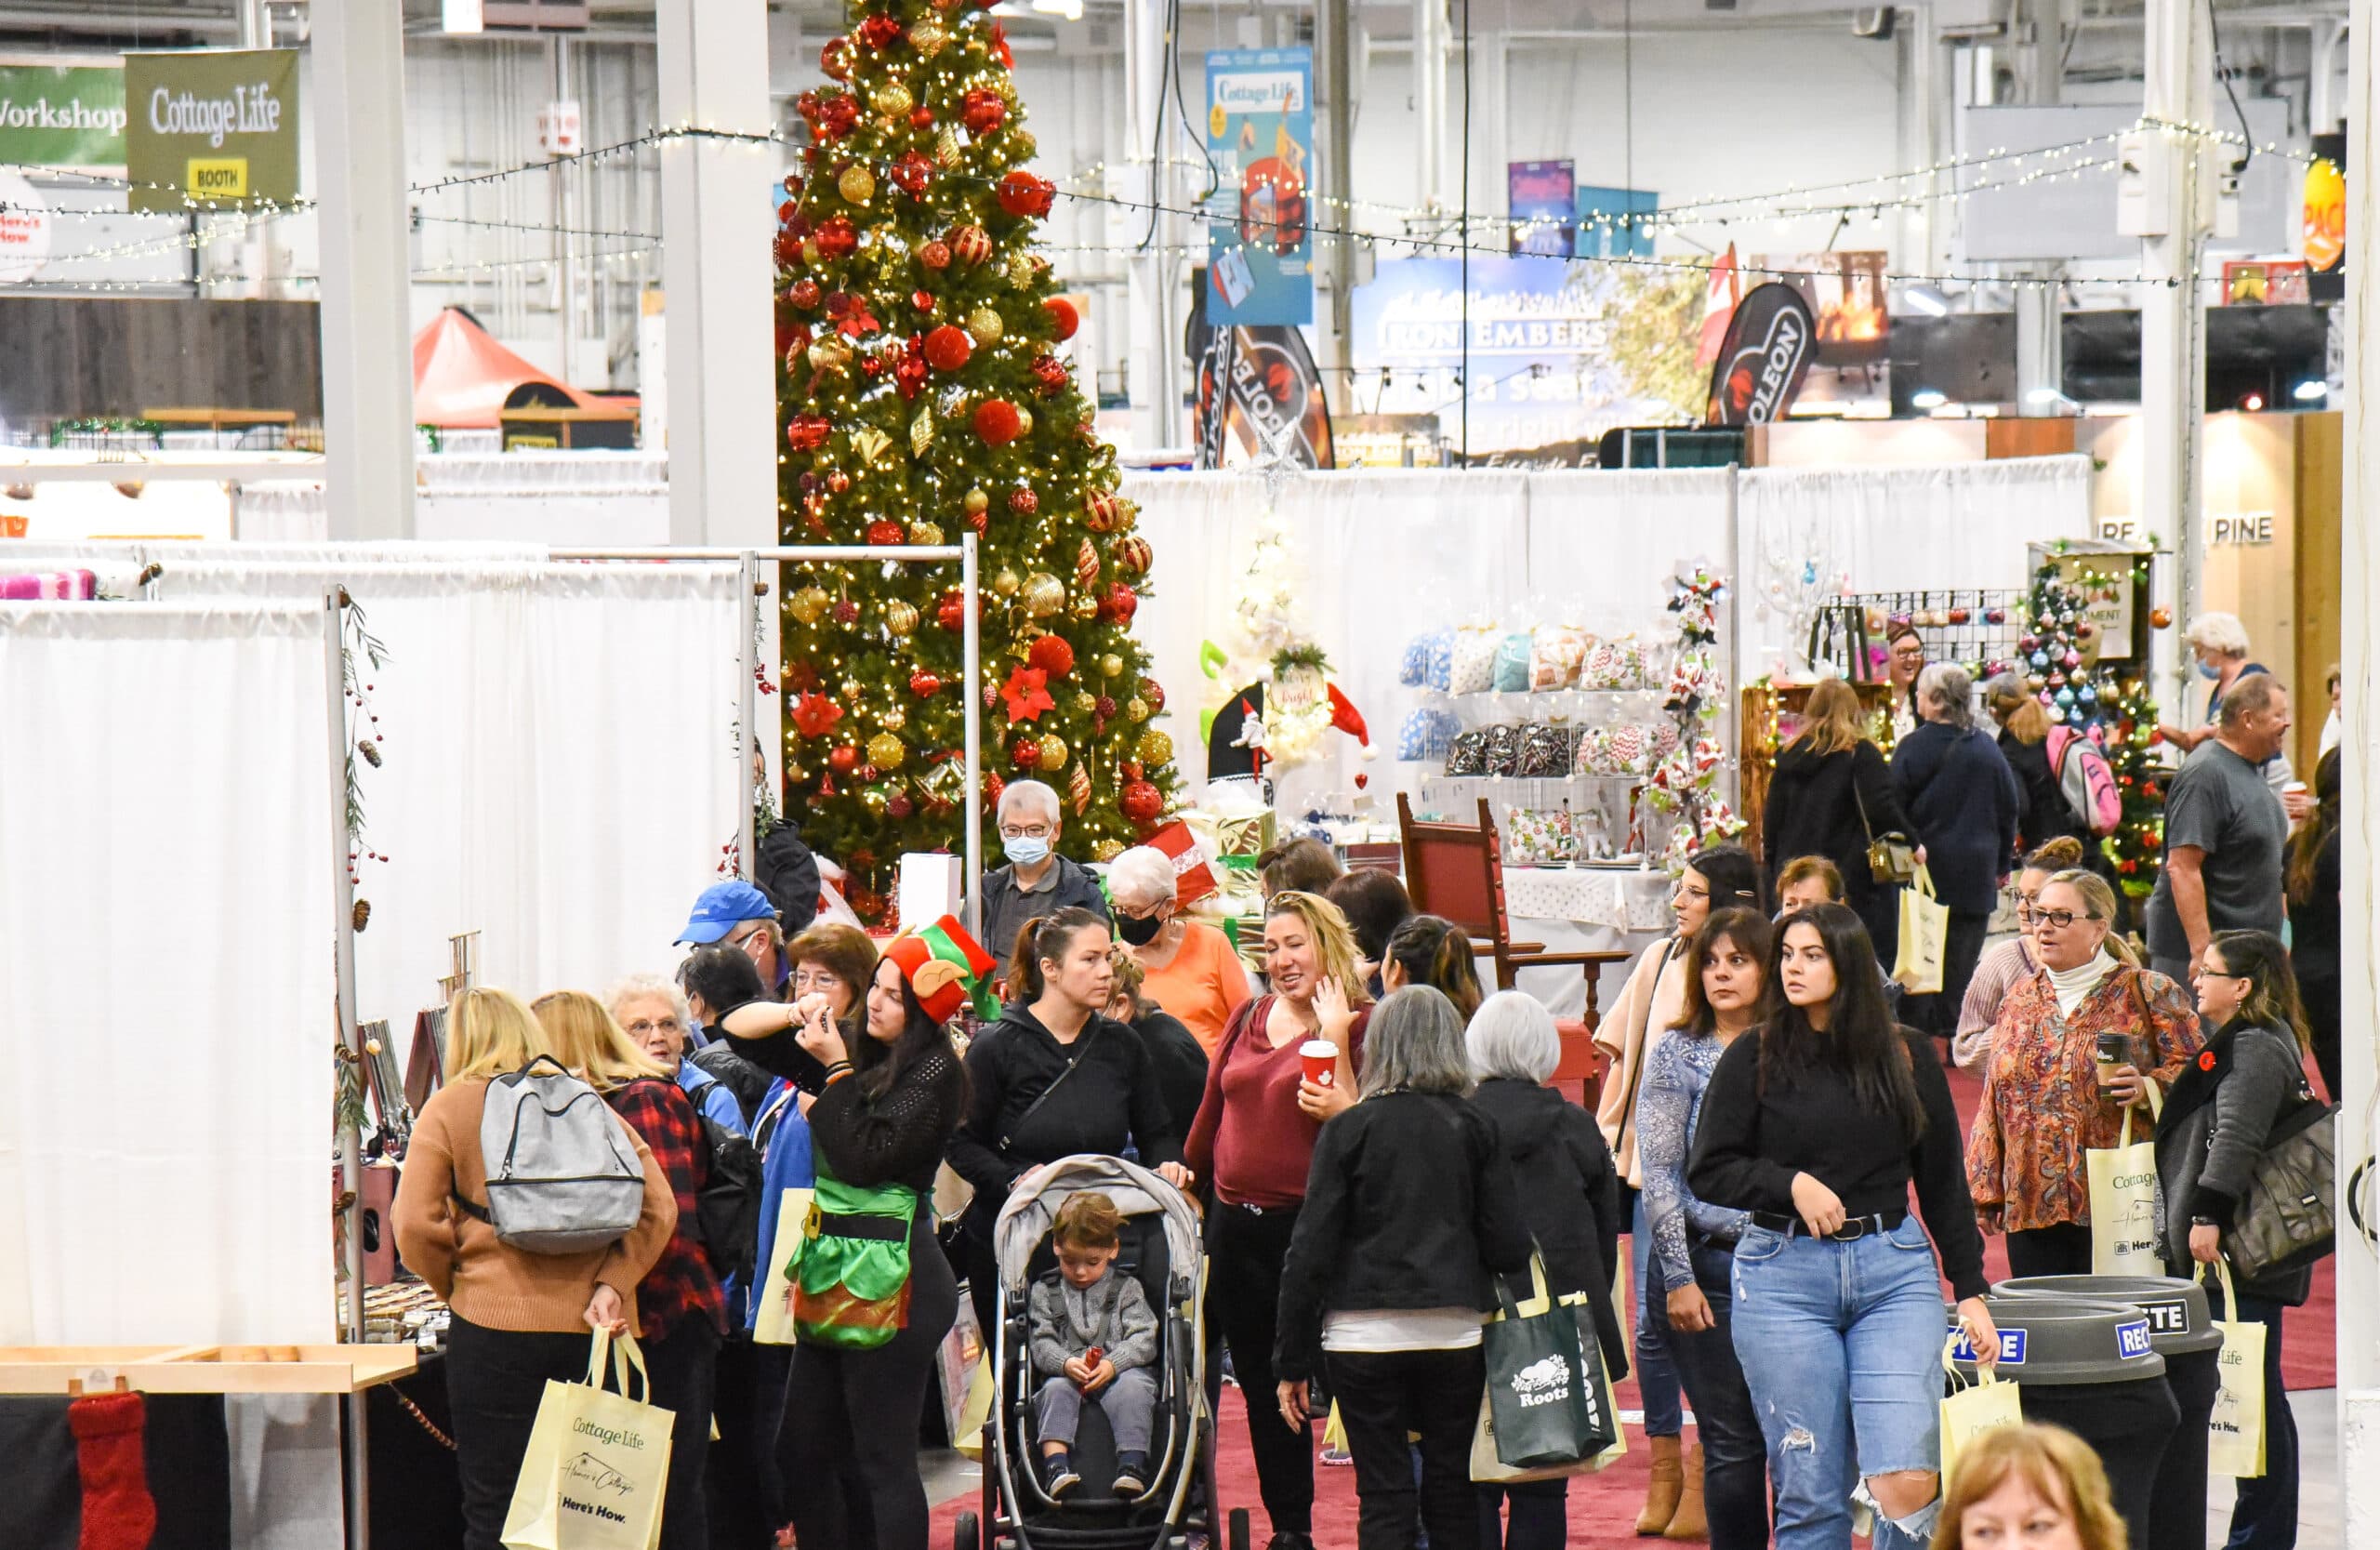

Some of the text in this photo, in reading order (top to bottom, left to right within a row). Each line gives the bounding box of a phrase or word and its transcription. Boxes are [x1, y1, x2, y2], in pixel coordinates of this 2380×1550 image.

[0, 98, 126, 137] orkshop
[150, 82, 281, 148] Cottage Life
[197, 168, 239, 188] BOOTH
[1473, 316, 1607, 349] EMBERS
[2215, 516, 2272, 541] PINE
[2142, 1305, 2183, 1330] TE
[2122, 1326, 2150, 1353] REC
[2221, 1349, 2242, 1366] Life
[1519, 1387, 1569, 1408] Roots
[573, 1416, 644, 1451] Cottage Life
[562, 1496, 626, 1524] Here's How.
